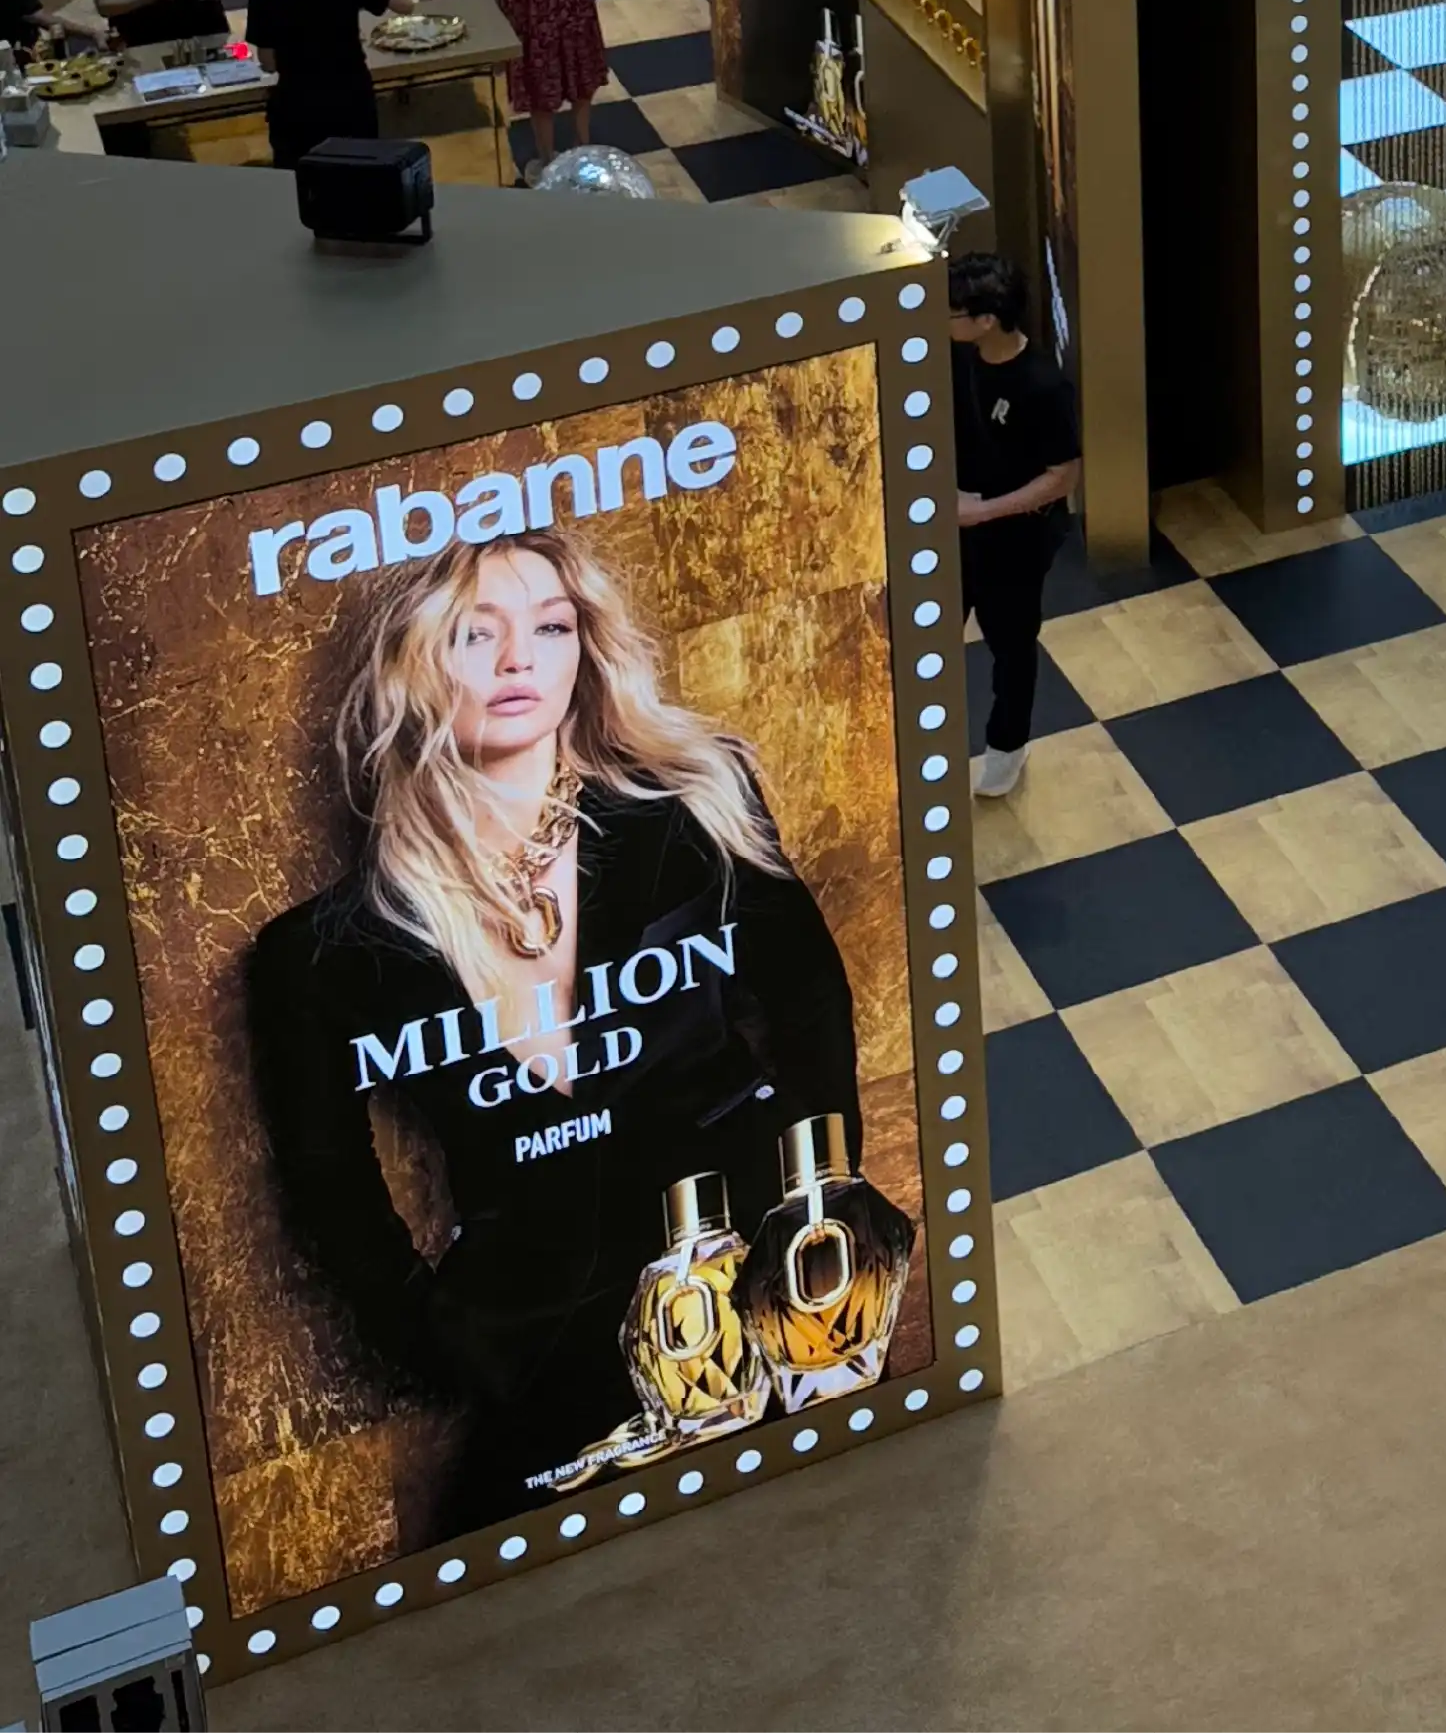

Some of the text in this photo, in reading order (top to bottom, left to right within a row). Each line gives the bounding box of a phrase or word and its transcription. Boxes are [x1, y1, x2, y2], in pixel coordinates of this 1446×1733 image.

[248, 420, 738, 597] rabanne
[349, 922, 738, 1092] MILLION
[467, 1026, 644, 1109] GOLD
[514, 1109, 613, 1164] PARFUM
[525, 1430, 667, 1489] THE NEW FRAGRANCE
